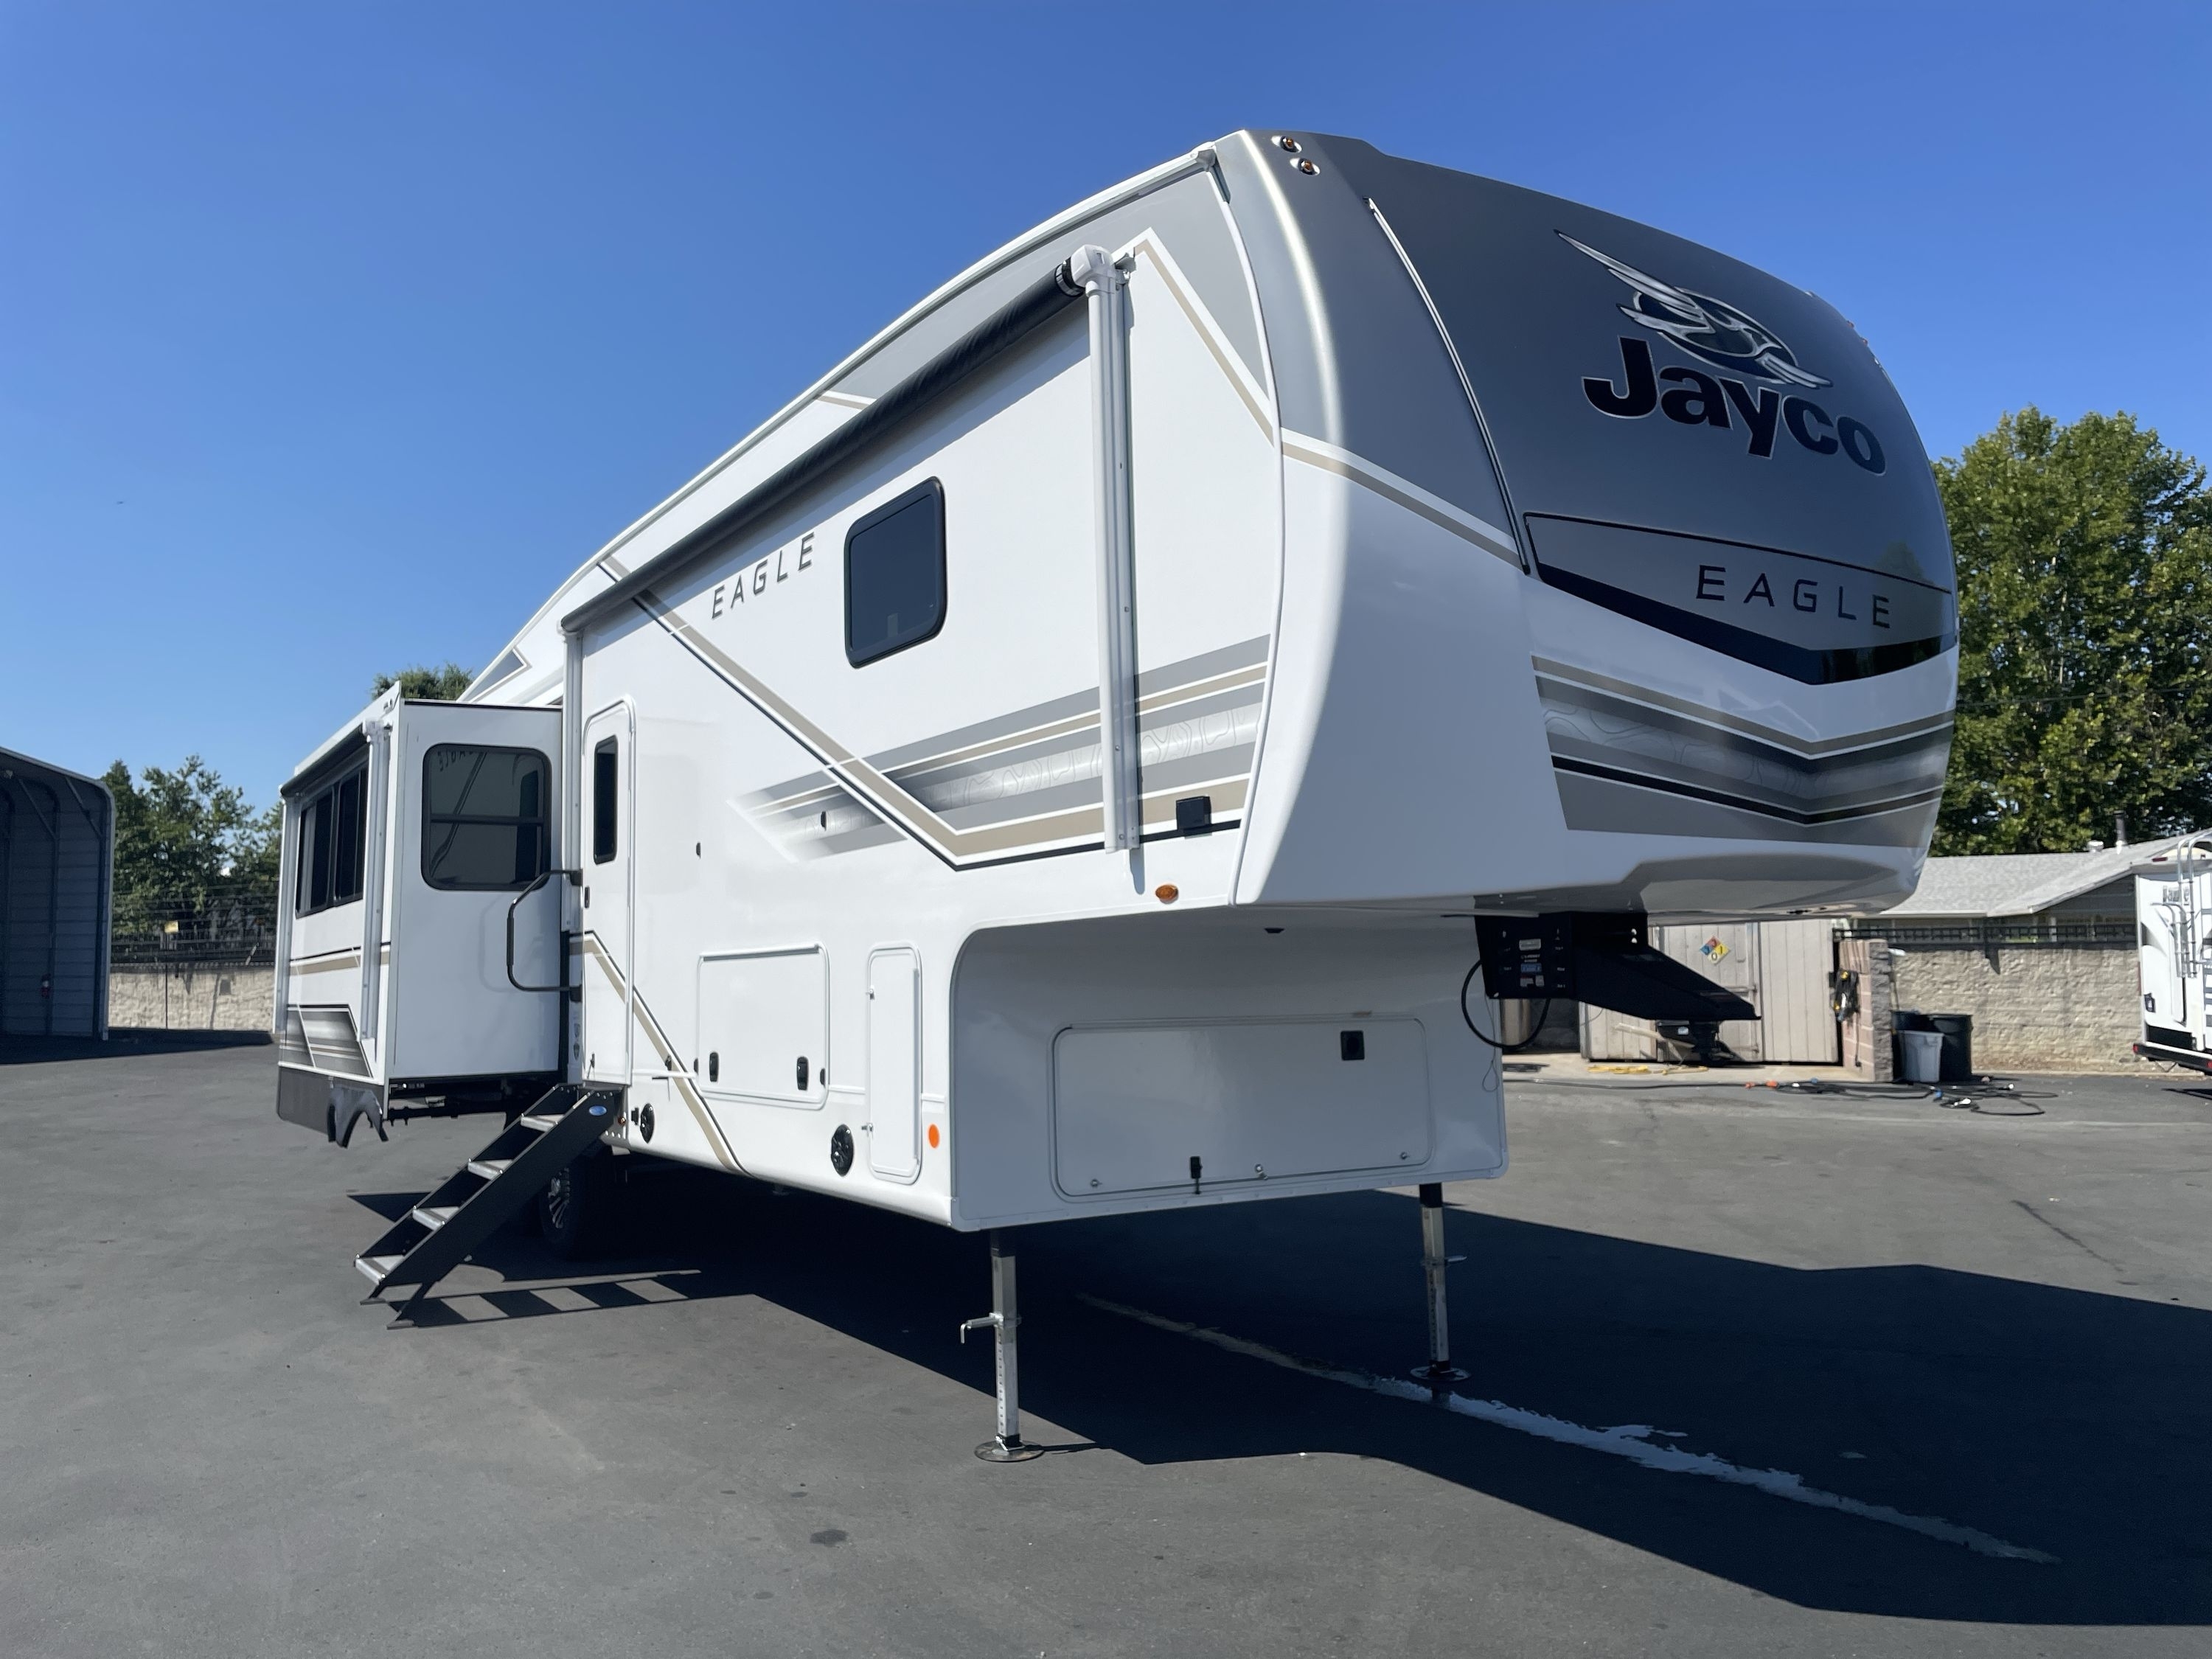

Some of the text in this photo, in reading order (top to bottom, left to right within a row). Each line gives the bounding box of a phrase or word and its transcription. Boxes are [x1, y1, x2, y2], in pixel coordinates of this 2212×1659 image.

[1581, 335, 1886, 476] Jayco
[712, 531, 815, 620] EAGLE
[1697, 565, 1891, 629] EAGLE
[1711, 953, 1718, 961] 0
